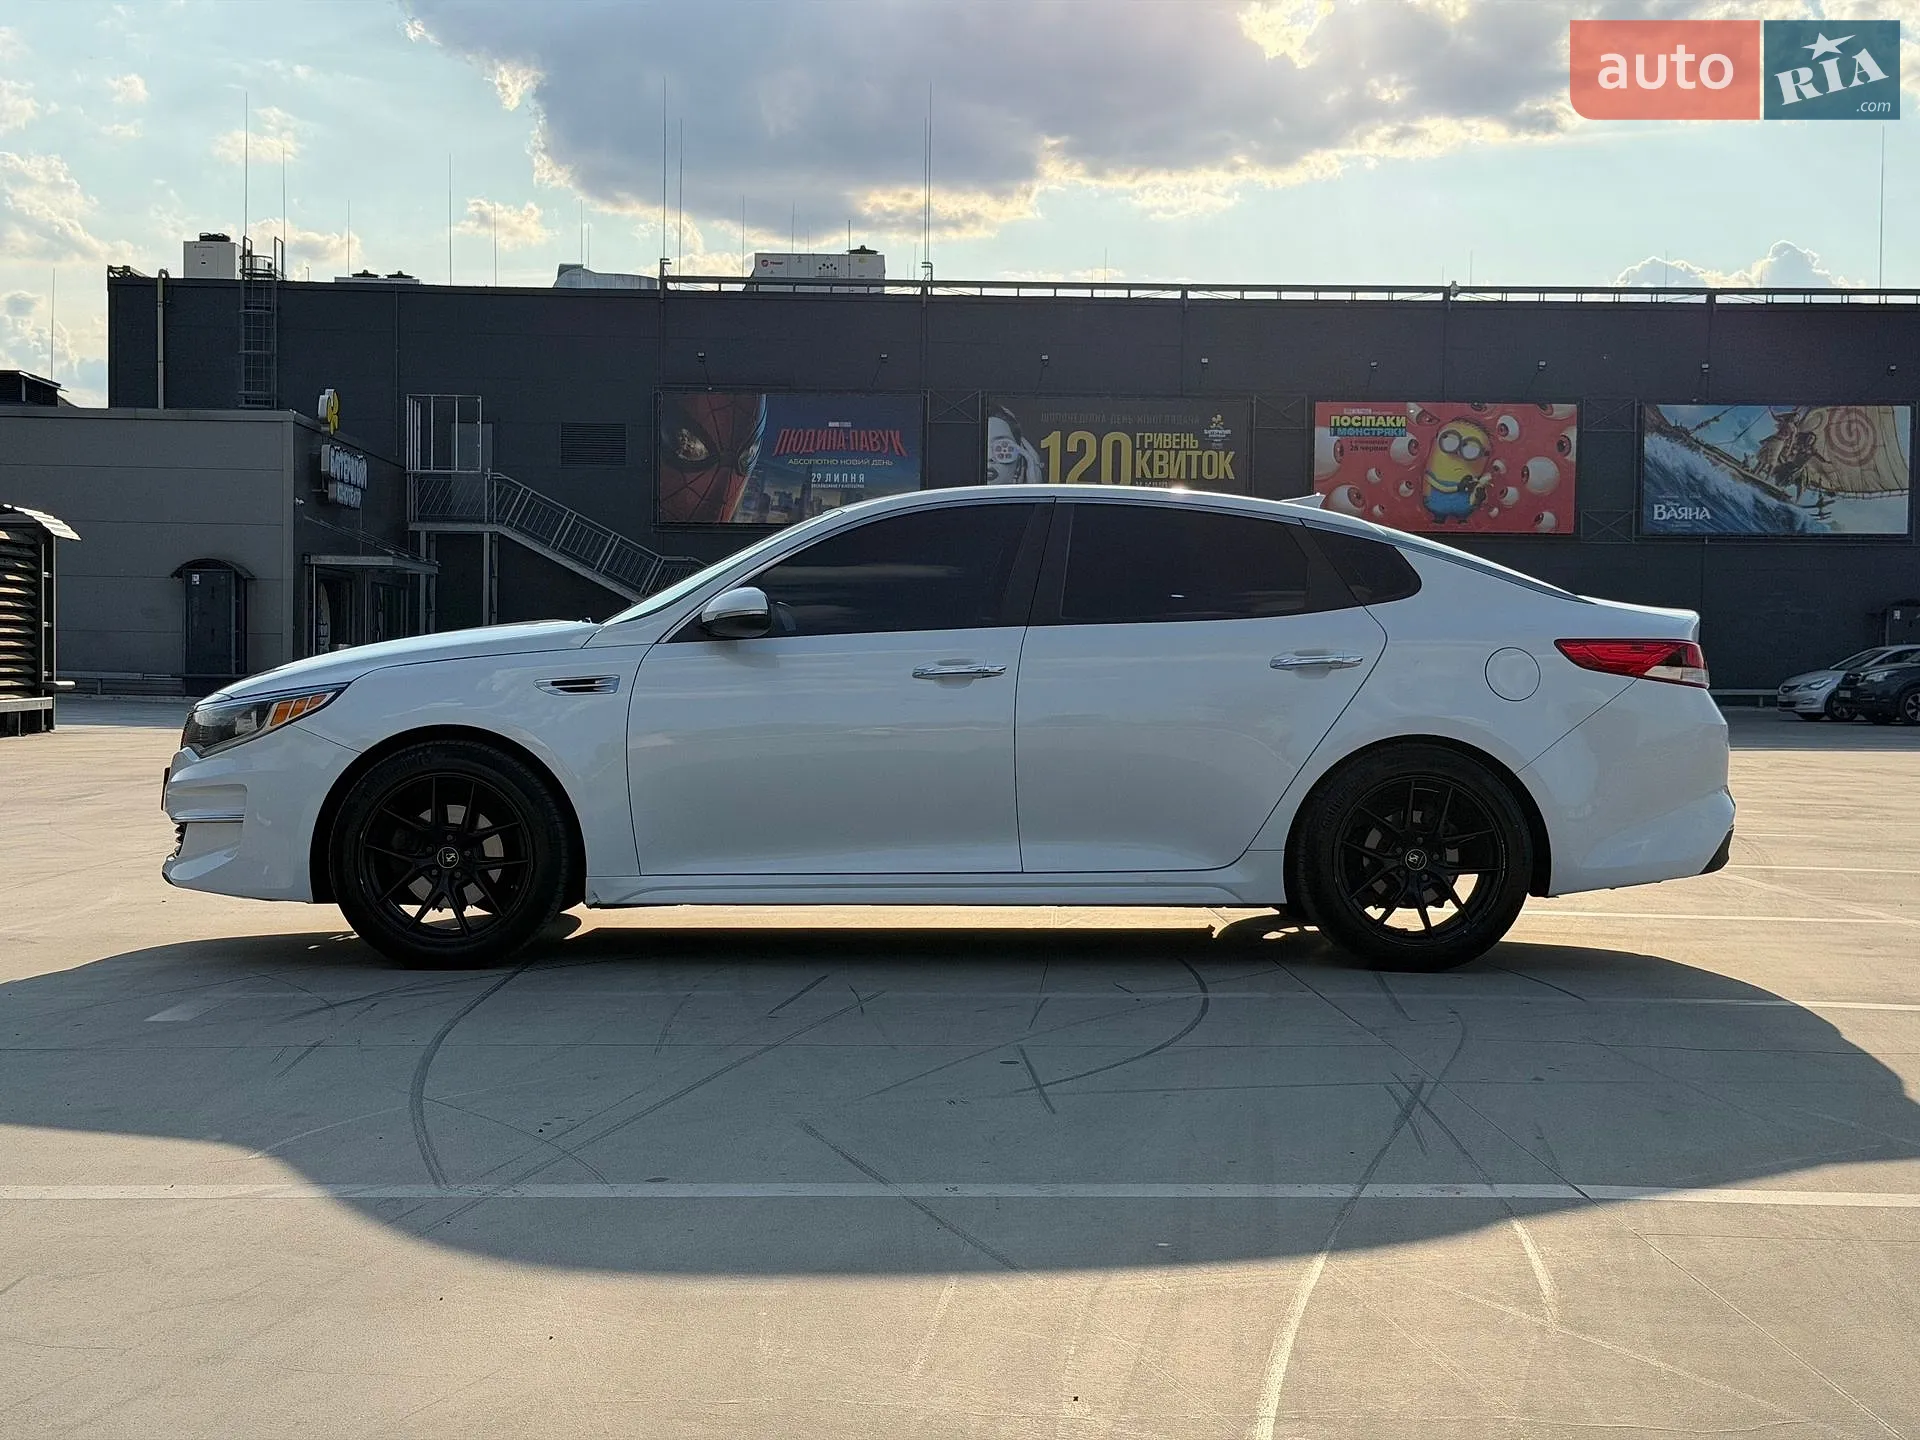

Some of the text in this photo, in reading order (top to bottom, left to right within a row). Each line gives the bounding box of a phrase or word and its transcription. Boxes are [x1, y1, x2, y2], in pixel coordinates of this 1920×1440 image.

[1330, 415, 1406, 427] ПОСІПАКИ
[1136, 432, 1199, 449] ГРИВЕНЬ
[840, 457, 869, 465] НОВИЙ
[871, 458, 893, 466] ДЕНЬ
[1040, 431, 1133, 485] 120
[1136, 451, 1235, 480] КВИТОК
[811, 472, 865, 483] 29 ЛИПНЯ
